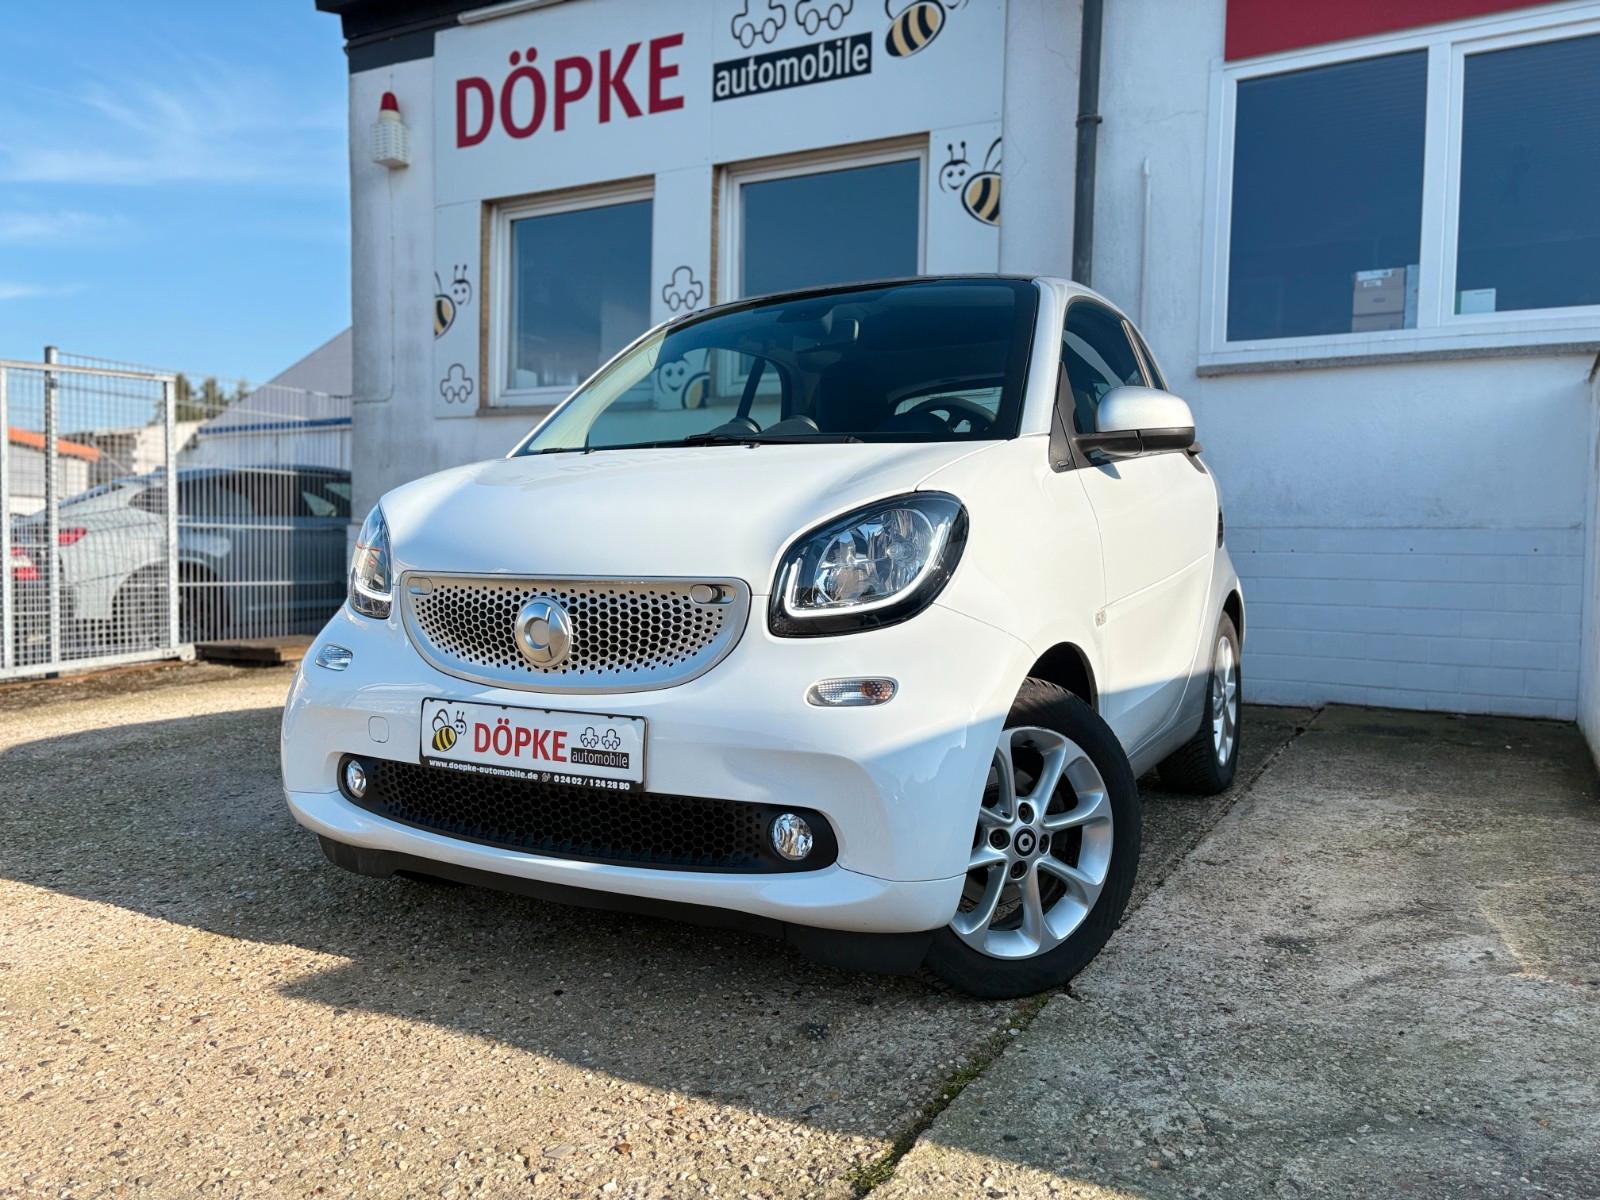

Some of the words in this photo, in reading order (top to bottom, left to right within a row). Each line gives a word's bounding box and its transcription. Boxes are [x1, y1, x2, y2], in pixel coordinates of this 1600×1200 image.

[456, 33, 684, 149] DÖPKE
[714, 38, 870, 98] automobile
[474, 718, 568, 763] DÖPKE
[572, 751, 628, 767] automobile
